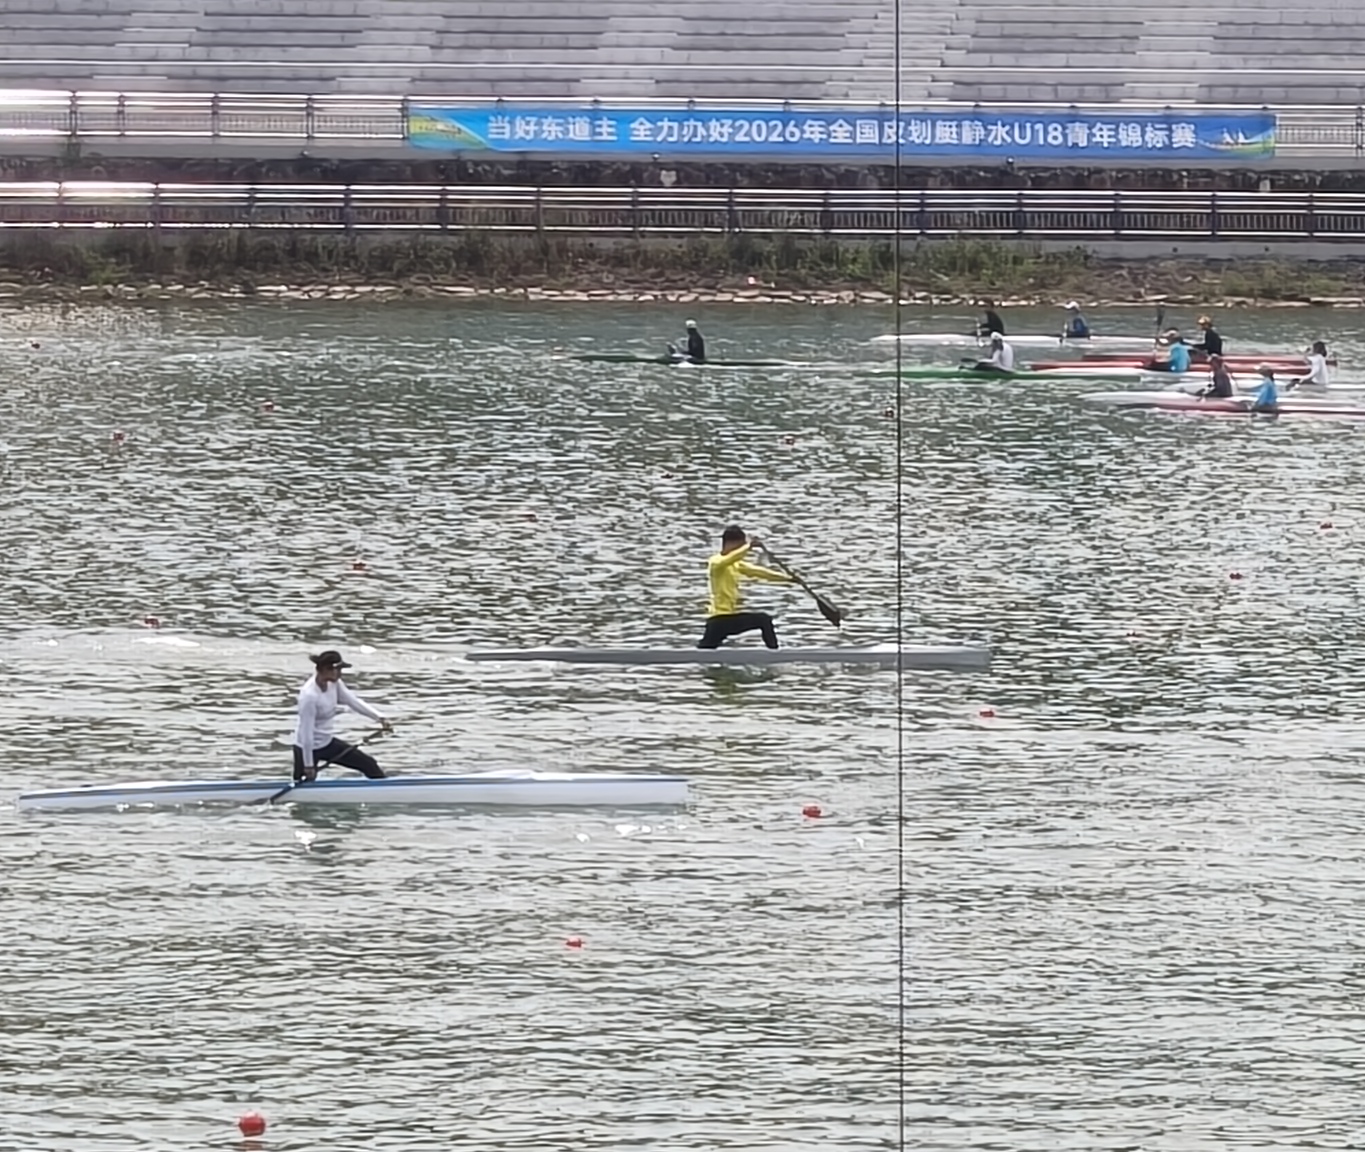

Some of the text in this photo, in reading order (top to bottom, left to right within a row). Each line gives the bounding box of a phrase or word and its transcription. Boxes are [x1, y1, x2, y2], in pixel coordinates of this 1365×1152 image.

[487, 116, 1197, 149] 当好东道主 全力办好2026年全国皮划艇静水U18青年锦标赛
